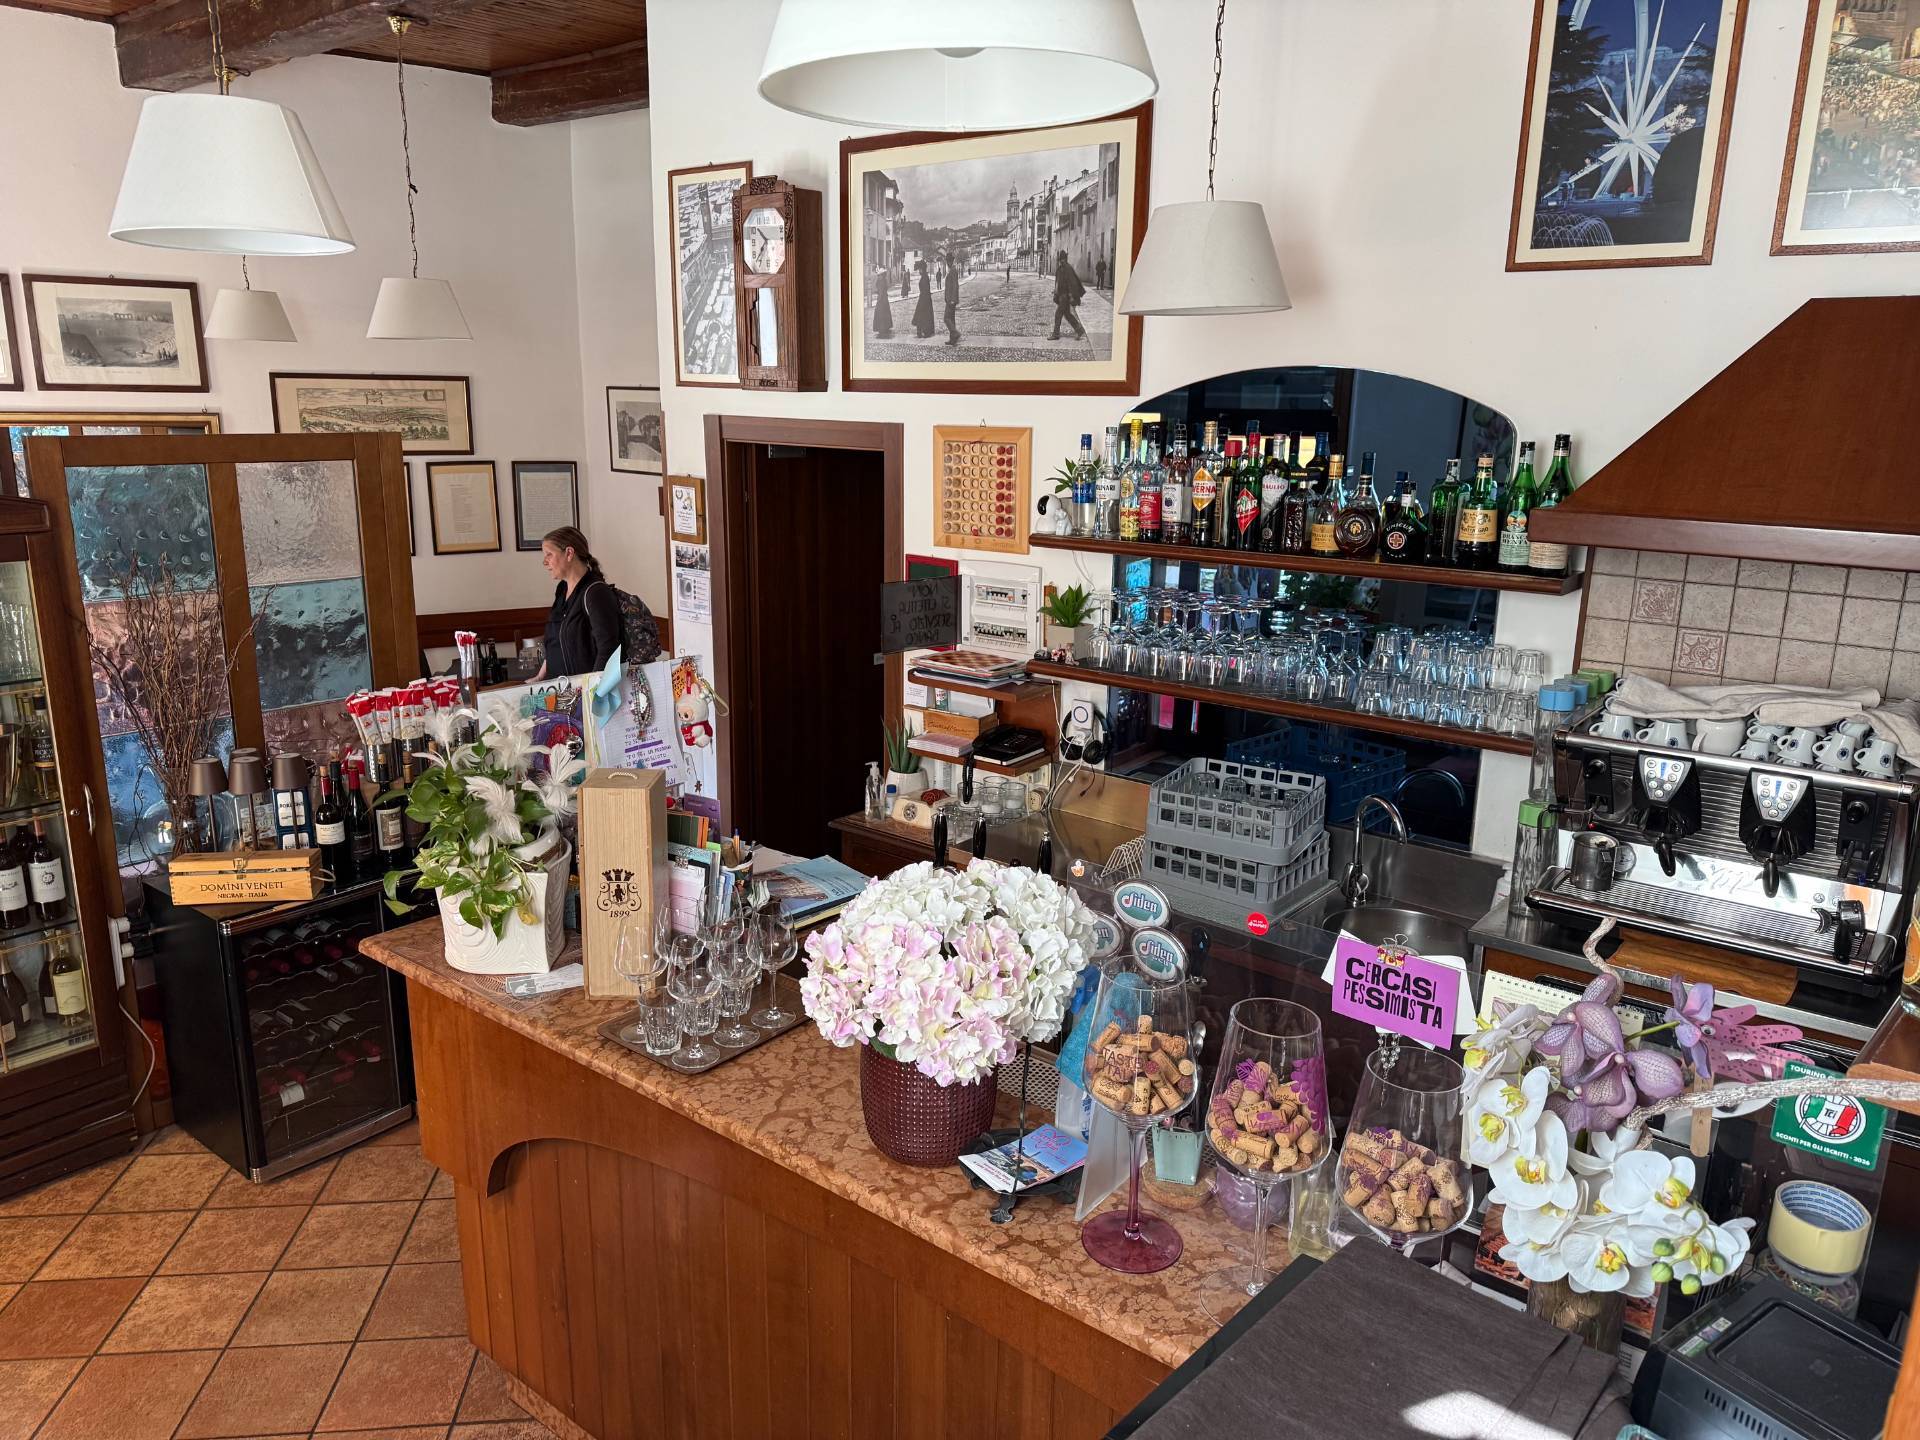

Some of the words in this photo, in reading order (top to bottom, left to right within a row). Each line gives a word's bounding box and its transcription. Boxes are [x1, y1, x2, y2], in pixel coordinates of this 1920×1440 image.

[1386, 521, 1415, 533] UNICUM
[247, 881, 284, 890] VENETI
[610, 910, 630, 918] 1899
[1345, 957, 1437, 1003] CERCASI
[1343, 979, 1443, 1029] PESSIMISTA
[1790, 1064, 1827, 1080] TOURING
[1776, 1131, 1799, 1143] SCONTI
[1799, 1139, 1812, 1148] PER
[1812, 1142, 1824, 1152] GLI
[1824, 1145, 1850, 1160] ISCRITTI
[1853, 1156, 1871, 1167] 2026
